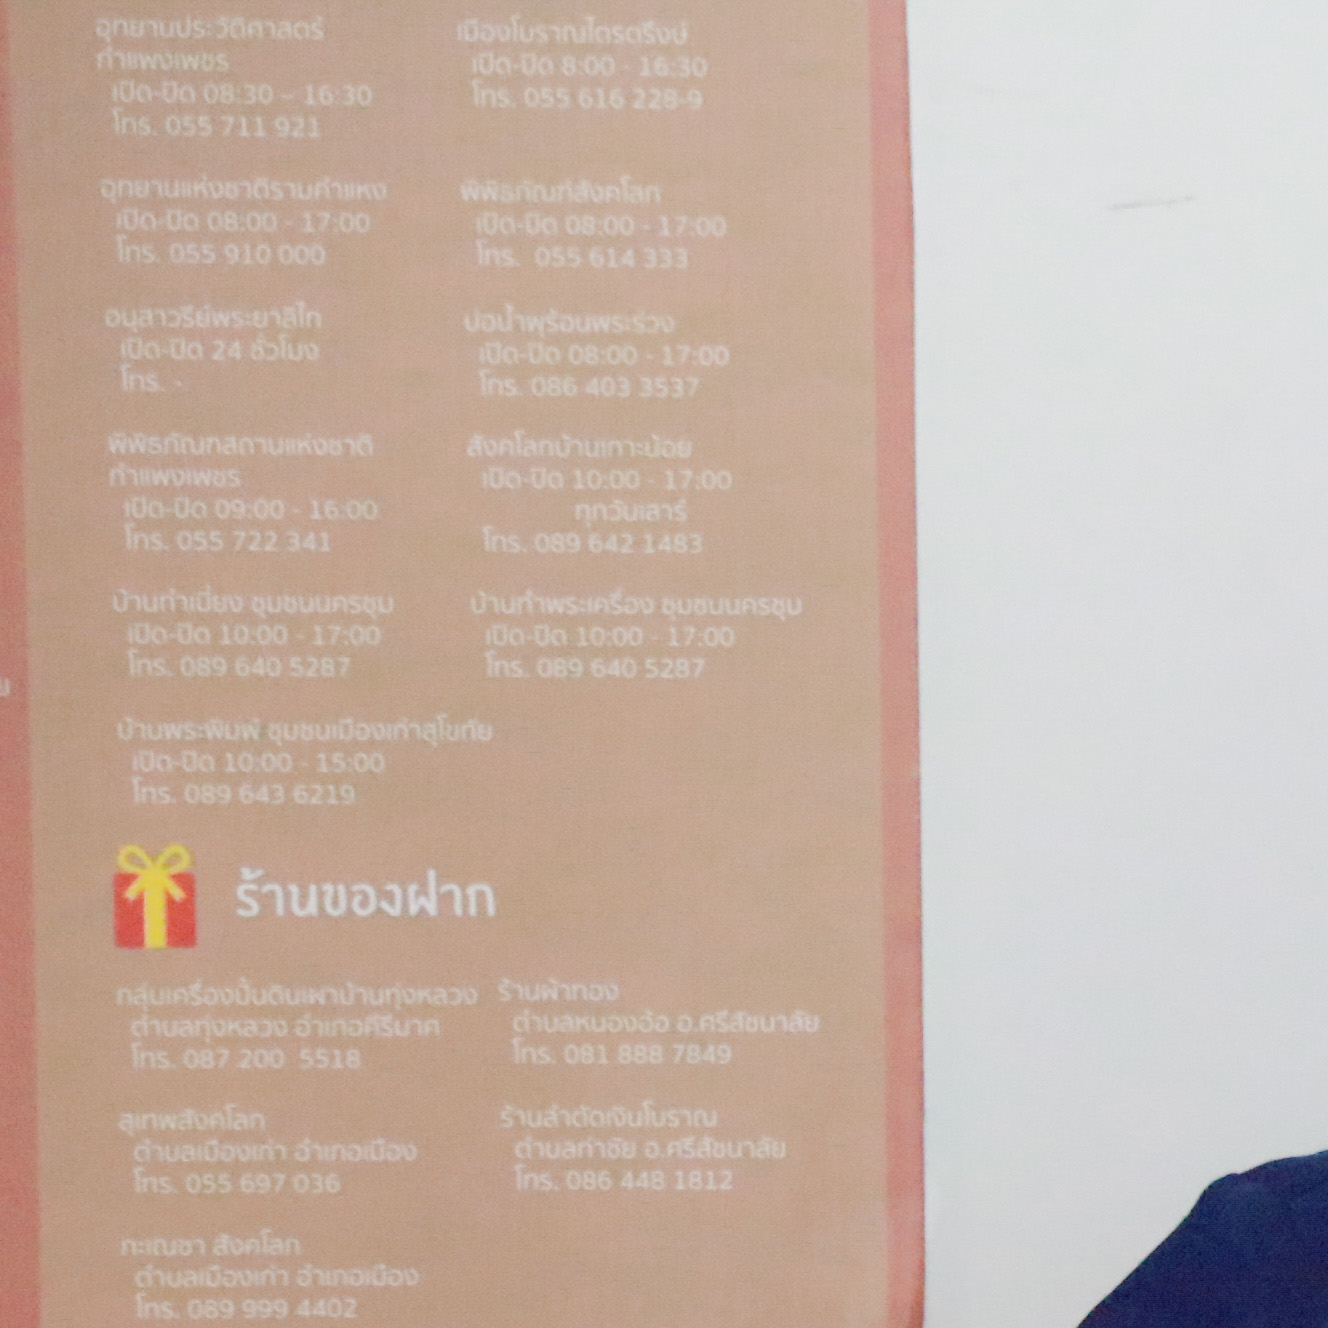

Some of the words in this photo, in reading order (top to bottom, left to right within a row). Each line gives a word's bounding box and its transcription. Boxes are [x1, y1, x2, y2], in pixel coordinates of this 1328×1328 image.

[471, 52, 554, 77] เปิด-ปิด
[561, 55, 616, 78] 8:00
[639, 55, 710, 79] 16:30
[111, 79, 197, 104] เปิด-ปิด
[203, 82, 274, 105] 08:30
[304, 83, 374, 107] 16:30
[523, 86, 571, 110] 055
[578, 87, 625, 110] 616
[164, 114, 213, 138] 055
[221, 115, 267, 138] 711
[273, 115, 321, 139] 921
[115, 208, 200, 232] เปิด-ปิด
[207, 210, 278, 233] 08:00
[302, 211, 371, 234] 17:00
[475, 211, 558, 236] เปิด-ปิด
[565, 214, 636, 237] 08:00
[659, 214, 728, 239] 17:00
[169, 242, 217, 265] 055
[223, 243, 272, 265] 910
[277, 243, 327, 266] 000
[534, 245, 583, 269] 055
[588, 247, 636, 269] 614
[643, 247, 689, 270] 333
[120, 336, 204, 361] เปิด-ปิด
[211, 338, 242, 362] 24
[478, 341, 561, 365] เปิด-ปิด
[568, 344, 639, 366] 08:00
[662, 344, 731, 367] 17:00
[530, 375, 578, 397] 086
[584, 376, 631, 398] 403
[639, 375, 700, 399] 3537
[481, 466, 564, 490] เปิด-ปิด
[573, 468, 641, 490] 10:00
[664, 468, 733, 491] 17:00
[122, 495, 207, 519] เปิด-ปิด
[214, 497, 286, 521] 09:00
[310, 498, 379, 521] 16:00
[176, 530, 224, 552] 055
[233, 530, 278, 552] 722
[287, 530, 331, 553] 341
[533, 532, 582, 554] 089
[586, 531, 634, 554] 642
[643, 532, 704, 555] 1483
[126, 622, 211, 645] เปิด-ปิด
[220, 624, 288, 646] 10:00
[312, 624, 382, 647] 17:00
[485, 623, 568, 647] เปิด-ปิด
[576, 625, 644, 647] 10:00
[666, 625, 736, 648] 17:00
[179, 655, 228, 677] 089
[234, 656, 283, 678] 640
[289, 656, 351, 678] 5287
[536, 657, 584, 679] 089
[589, 657, 638, 679] 640
[644, 657, 706, 680] 5287
[131, 749, 215, 773] เปิด-ปิด
[224, 751, 293, 773] 10:00
[315, 751, 386, 774] 15:00
[184, 783, 233, 805] 089
[238, 783, 285, 805] 643
[292, 783, 356, 806] 6219
[183, 1048, 230, 1070] 087
[237, 1048, 286, 1070] 200
[299, 1047, 362, 1070] 5518
[563, 1043, 609, 1065] 081
[617, 1043, 664, 1065] 888
[673, 1043, 733, 1065] 7849
[185, 1173, 233, 1195] 055
[239, 1172, 286, 1194] 697
[292, 1172, 341, 1194] 036
[565, 1170, 613, 1191] 086
[620, 1169, 666, 1191] 448
[674, 1169, 734, 1191] 1812
[187, 1298, 236, 1320] 089
[241, 1298, 289, 1319] 999
[296, 1297, 358, 1319] 4402
